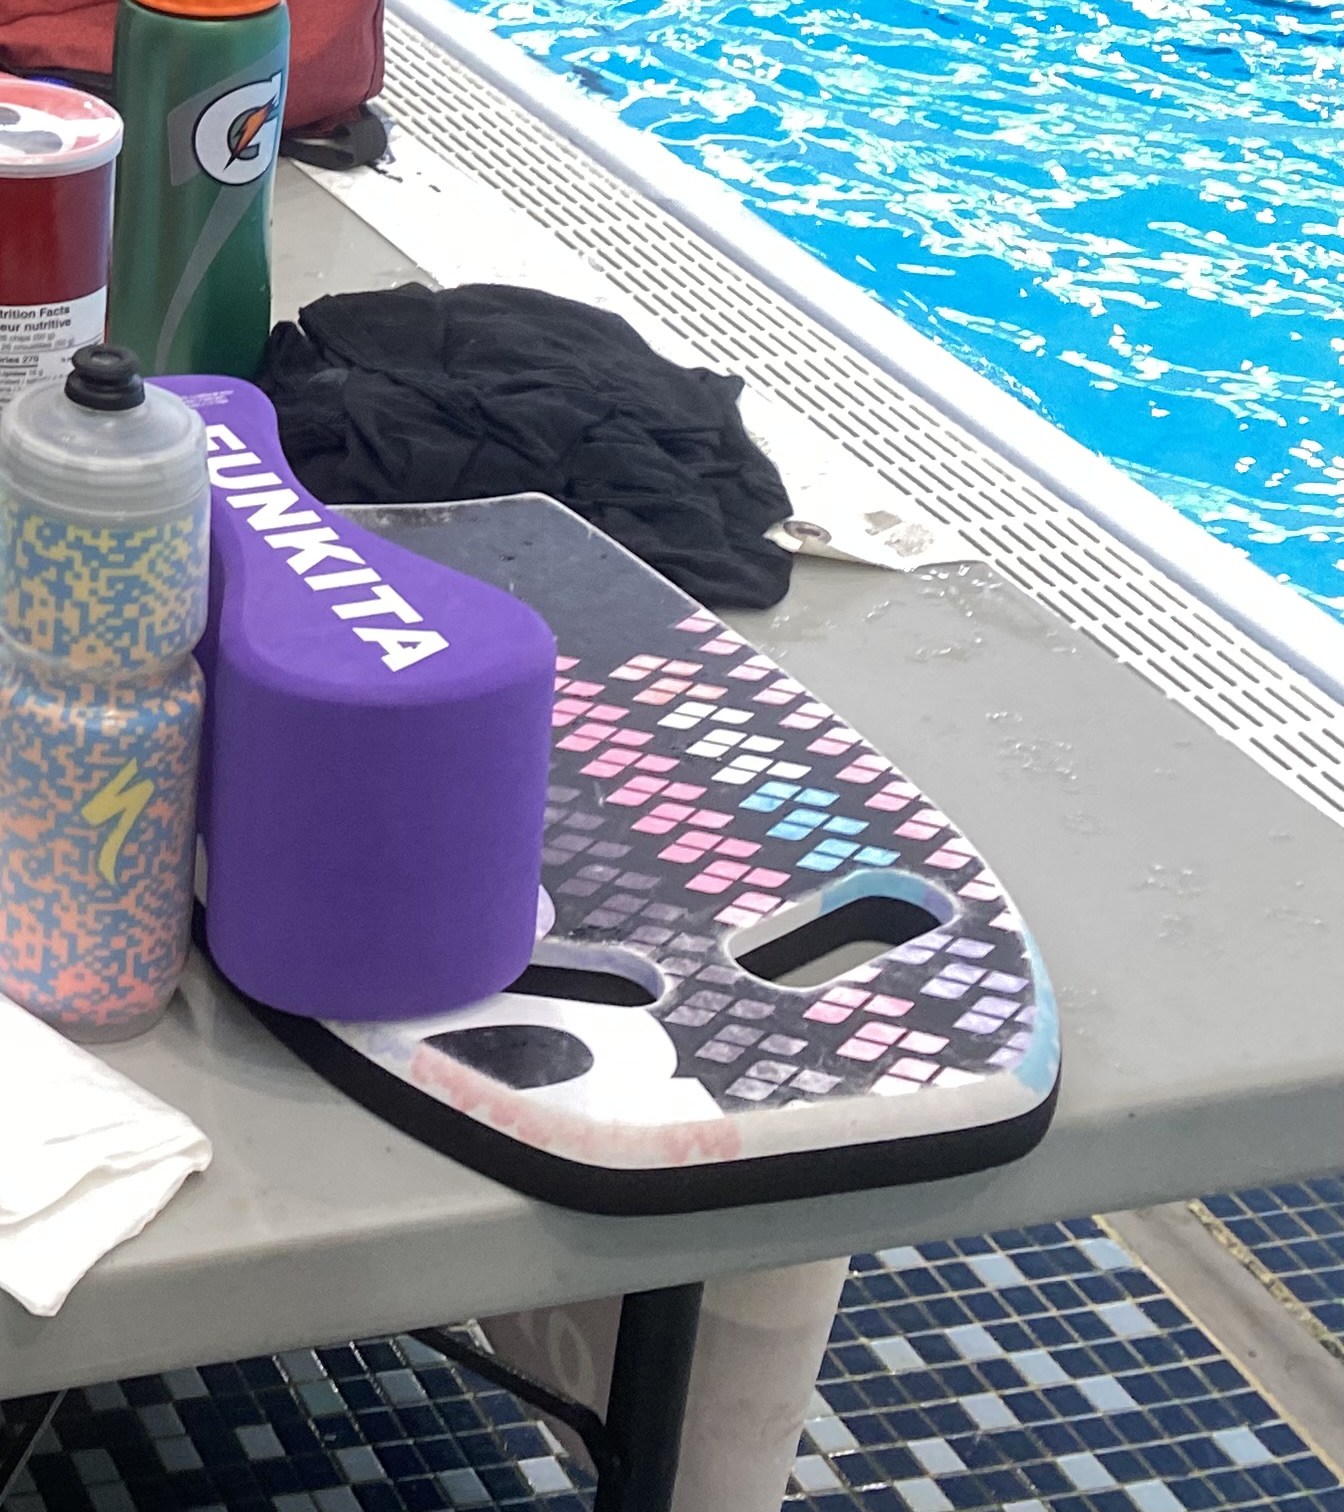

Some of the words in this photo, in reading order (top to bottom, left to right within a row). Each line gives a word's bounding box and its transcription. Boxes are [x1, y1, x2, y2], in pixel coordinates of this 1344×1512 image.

[40, 305, 70, 317] Facts
[24, 319, 71, 331] nutritive
[205, 424, 450, 672] FUNKITA
